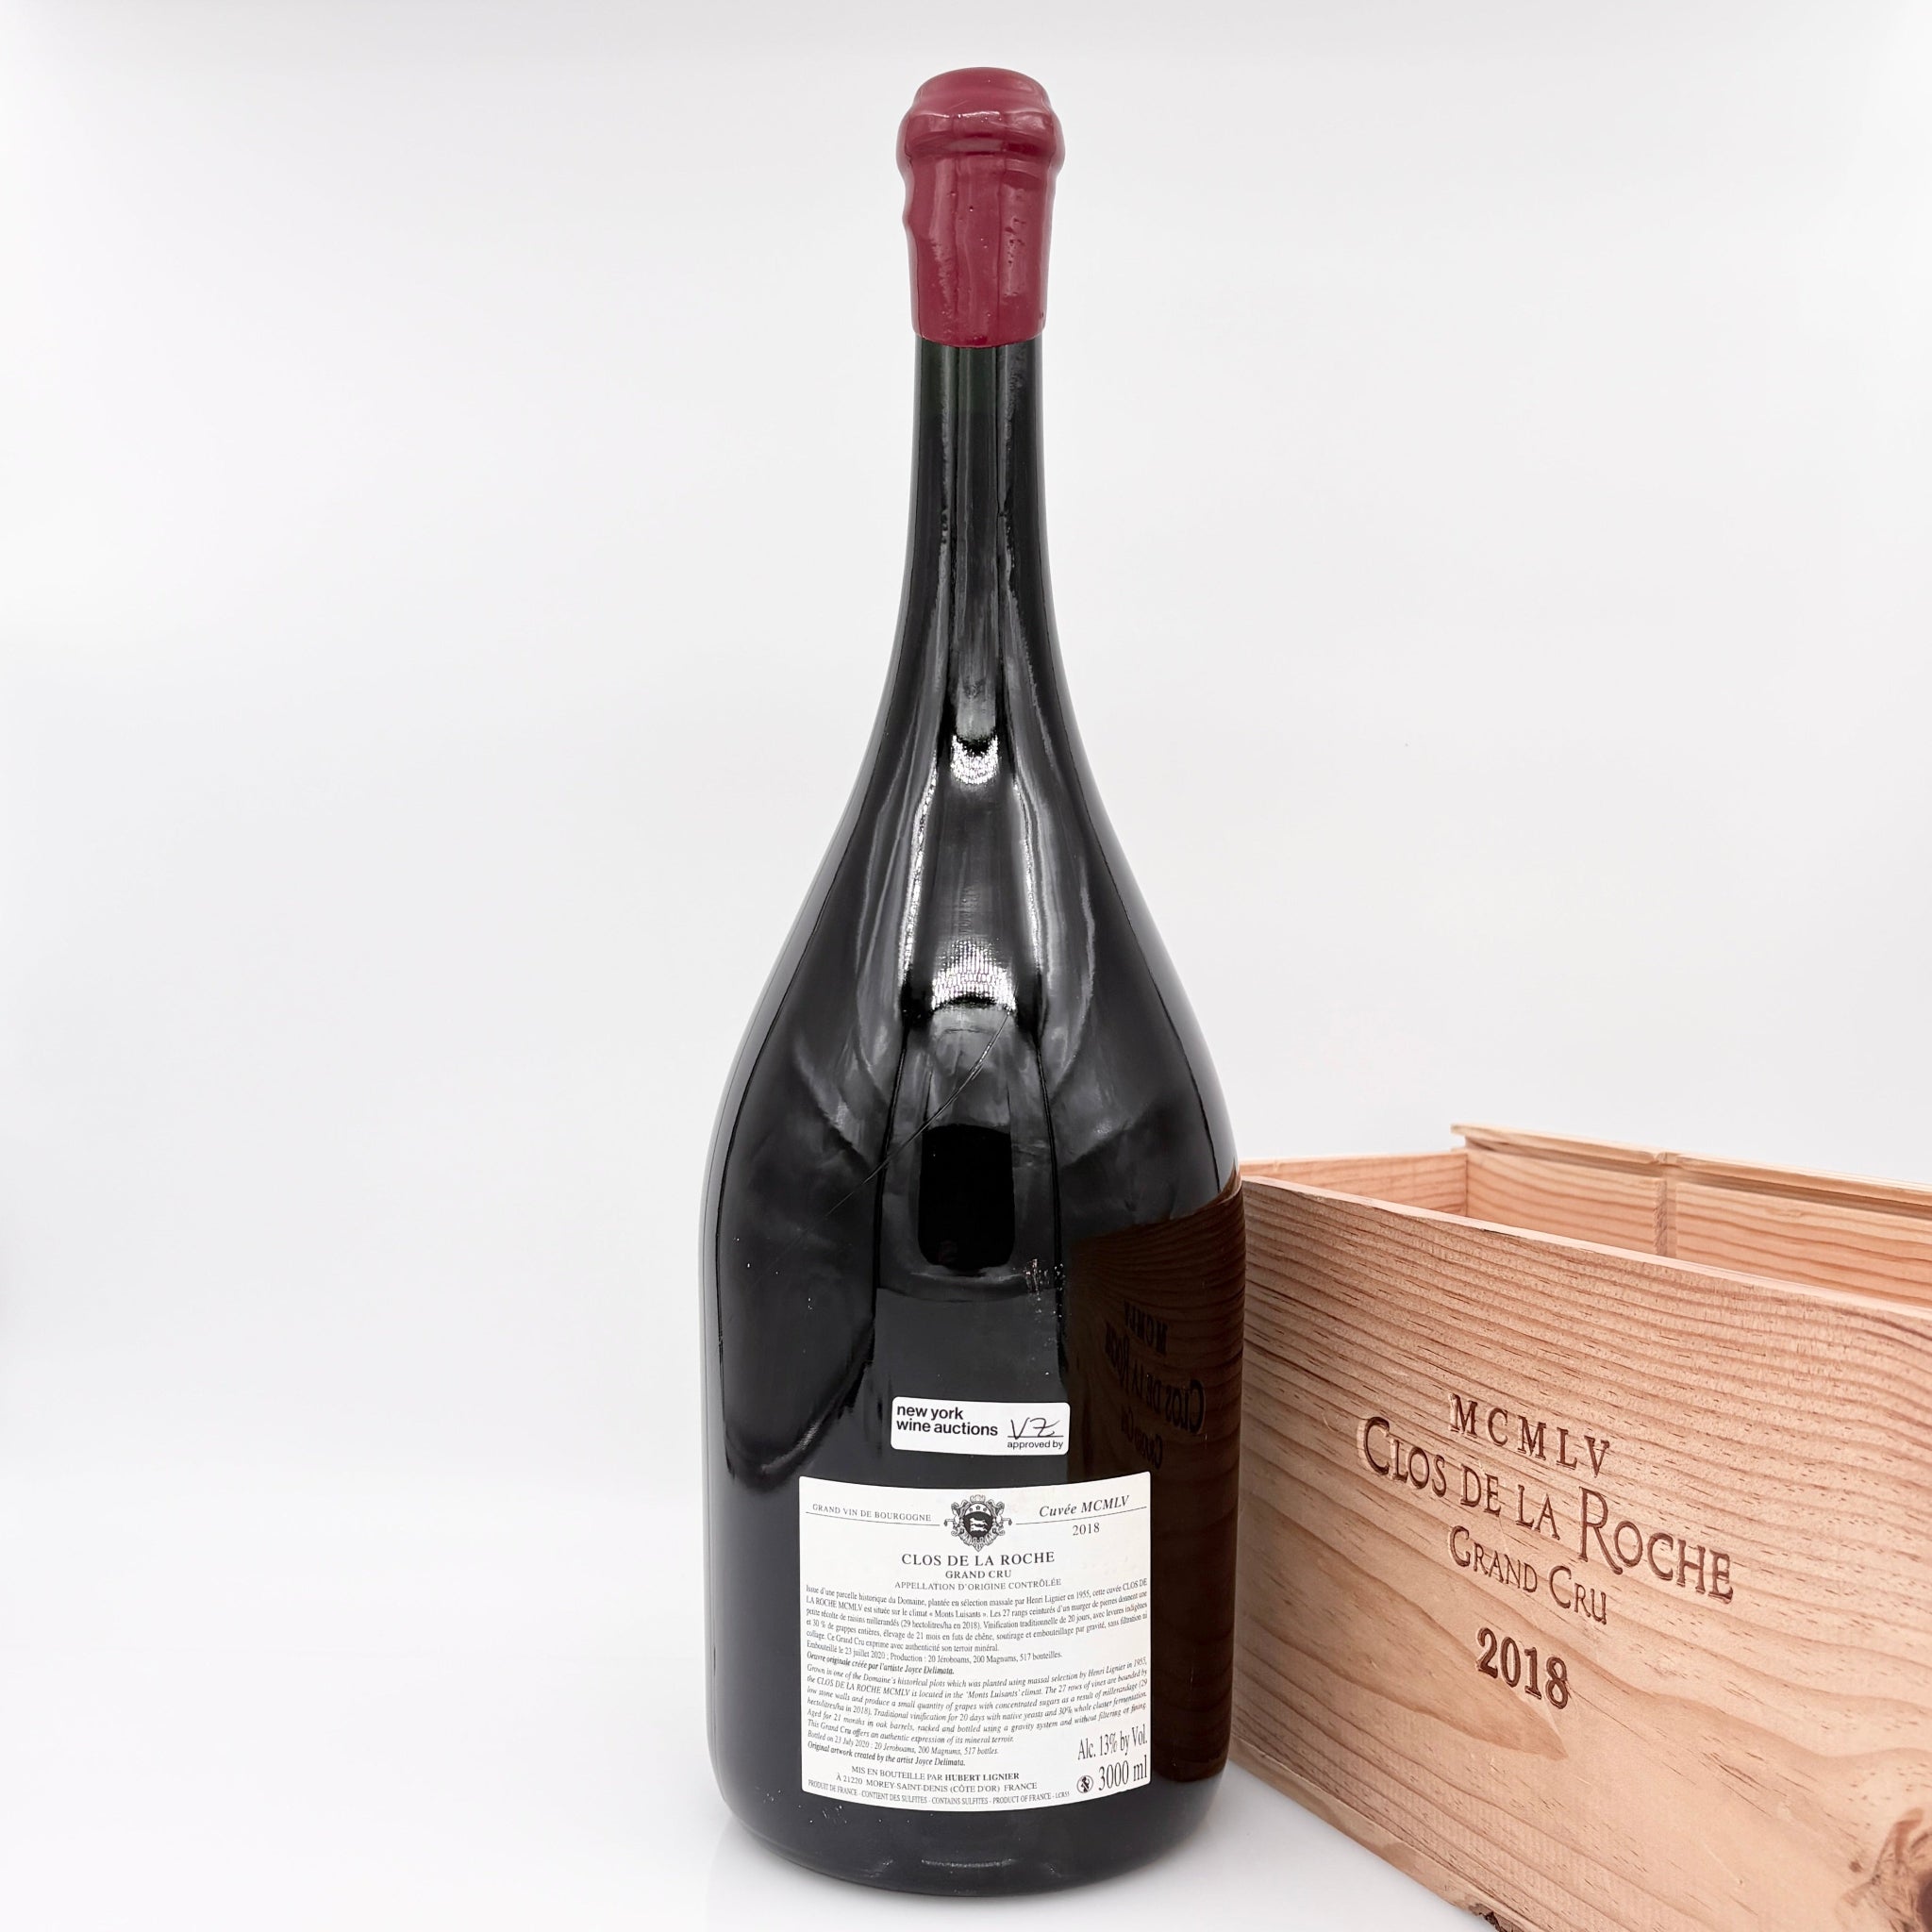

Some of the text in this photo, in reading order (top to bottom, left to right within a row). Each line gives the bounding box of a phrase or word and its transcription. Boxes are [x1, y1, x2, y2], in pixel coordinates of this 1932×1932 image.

[897, 1406, 964, 1421] new york
[896, 1419, 998, 1436] wine auctions
[1449, 1392, 1610, 1477] MCMLV
[1008, 1441, 1064, 1450] approved by
[812, 1504, 931, 1522] GRAND VIN DE BOURGOGNE
[1039, 1495, 1130, 1518] Cuvée MCMLV
[1073, 1523, 1100, 1536] 2018
[901, 1551, 1055, 1567] CLOS DE LA ROCHE
[945, 1570, 1011, 1579] GRAND CRU
[894, 1578, 1061, 1591] APPELLATION D'ORIGINE CONTRÔLÉE
[1476, 1627, 1569, 1709] 2018
[1077, 1724, 1148, 1760] Alc. 13% by Vol.
[851, 1765, 866, 1774] MIS
[866, 1767, 878, 1775] EN
[879, 1769, 925, 1780] BOUTEILLE
[926, 1773, 942, 1781] PAR
[982, 1772, 1019, 1781] LIGNIER
[1098, 1755, 1147, 1791] 3000 ml
[842, 1774, 863, 1785] 21220
[1003, 1781, 1038, 1791] FRANCE
[828, 1783, 836, 1791] DE
[837, 1785, 858, 1795] FRANCE
[860, 1790, 889, 1799] CONTIENT
[901, 1794, 927, 1803] SULFITES
[991, 1795, 1019, 1804] PRODUCT
[1028, 1791, 1052, 1801] FRANCE
